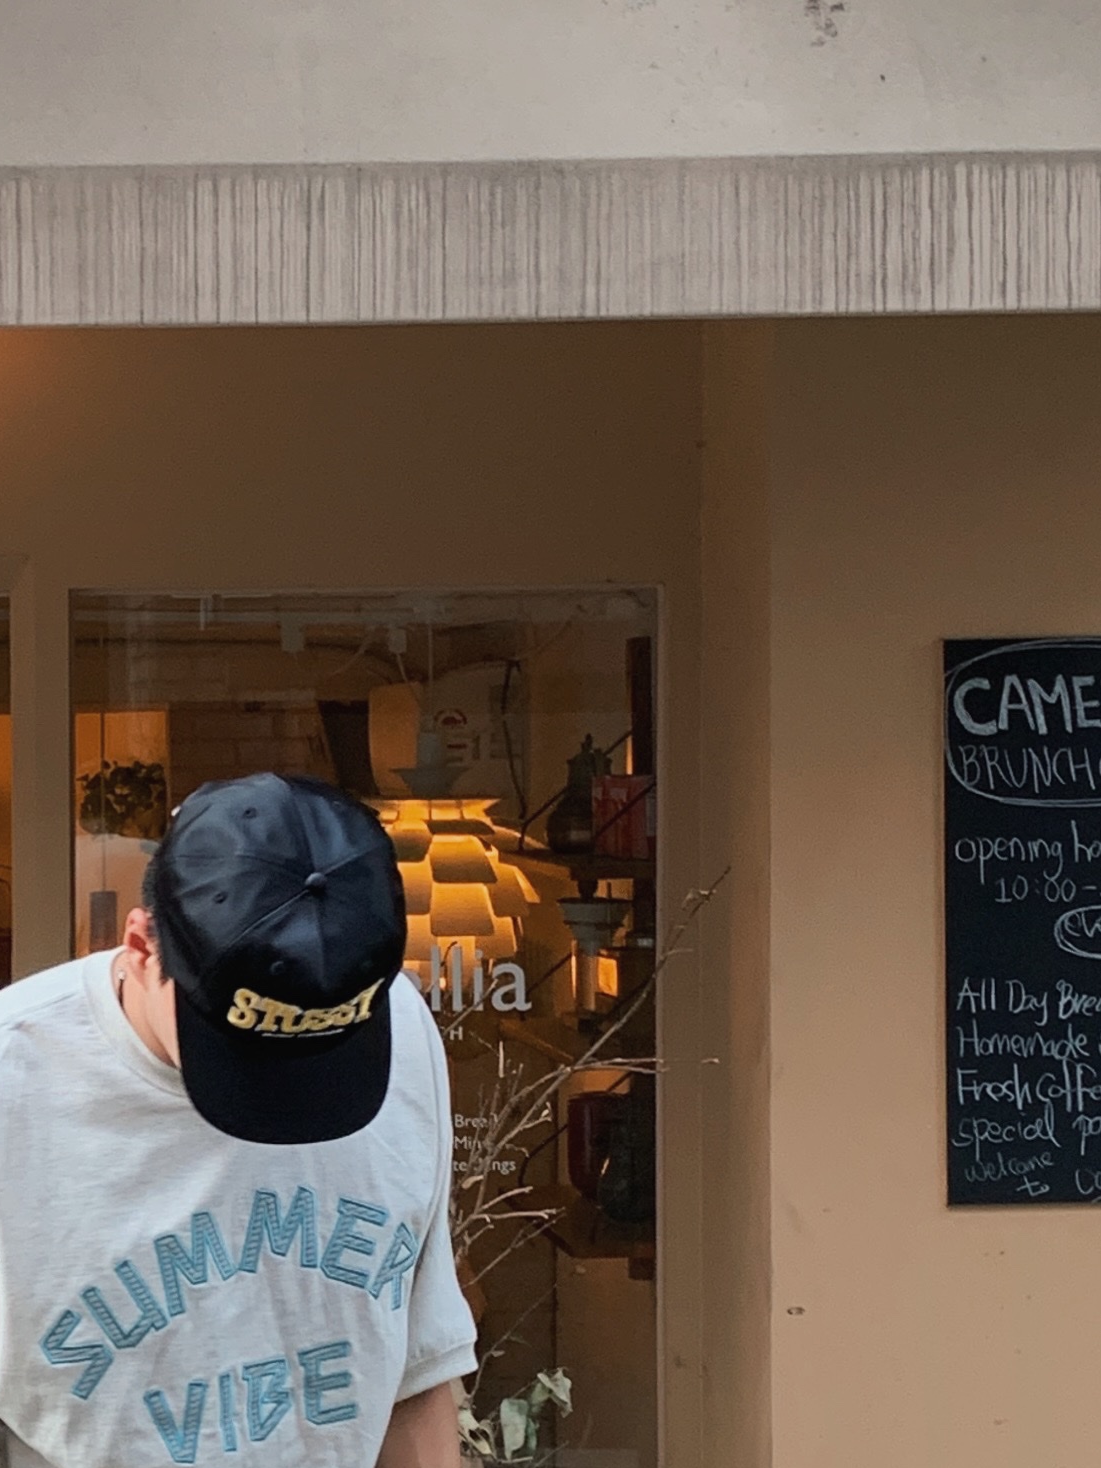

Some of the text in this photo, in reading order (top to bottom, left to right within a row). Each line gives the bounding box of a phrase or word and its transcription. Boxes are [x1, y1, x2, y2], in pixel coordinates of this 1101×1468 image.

[953, 674, 1101, 736] CAME
[958, 744, 1096, 794] BRUNCH
[955, 836, 1064, 885] opening
[956, 977, 997, 1013] All
[1005, 978, 1048, 1026] Day
[956, 1063, 1032, 1110] Fresh
[952, 1098, 1061, 1161] special
[38, 1184, 420, 1401] SUMMER
[143, 1340, 360, 1464] VIBE
